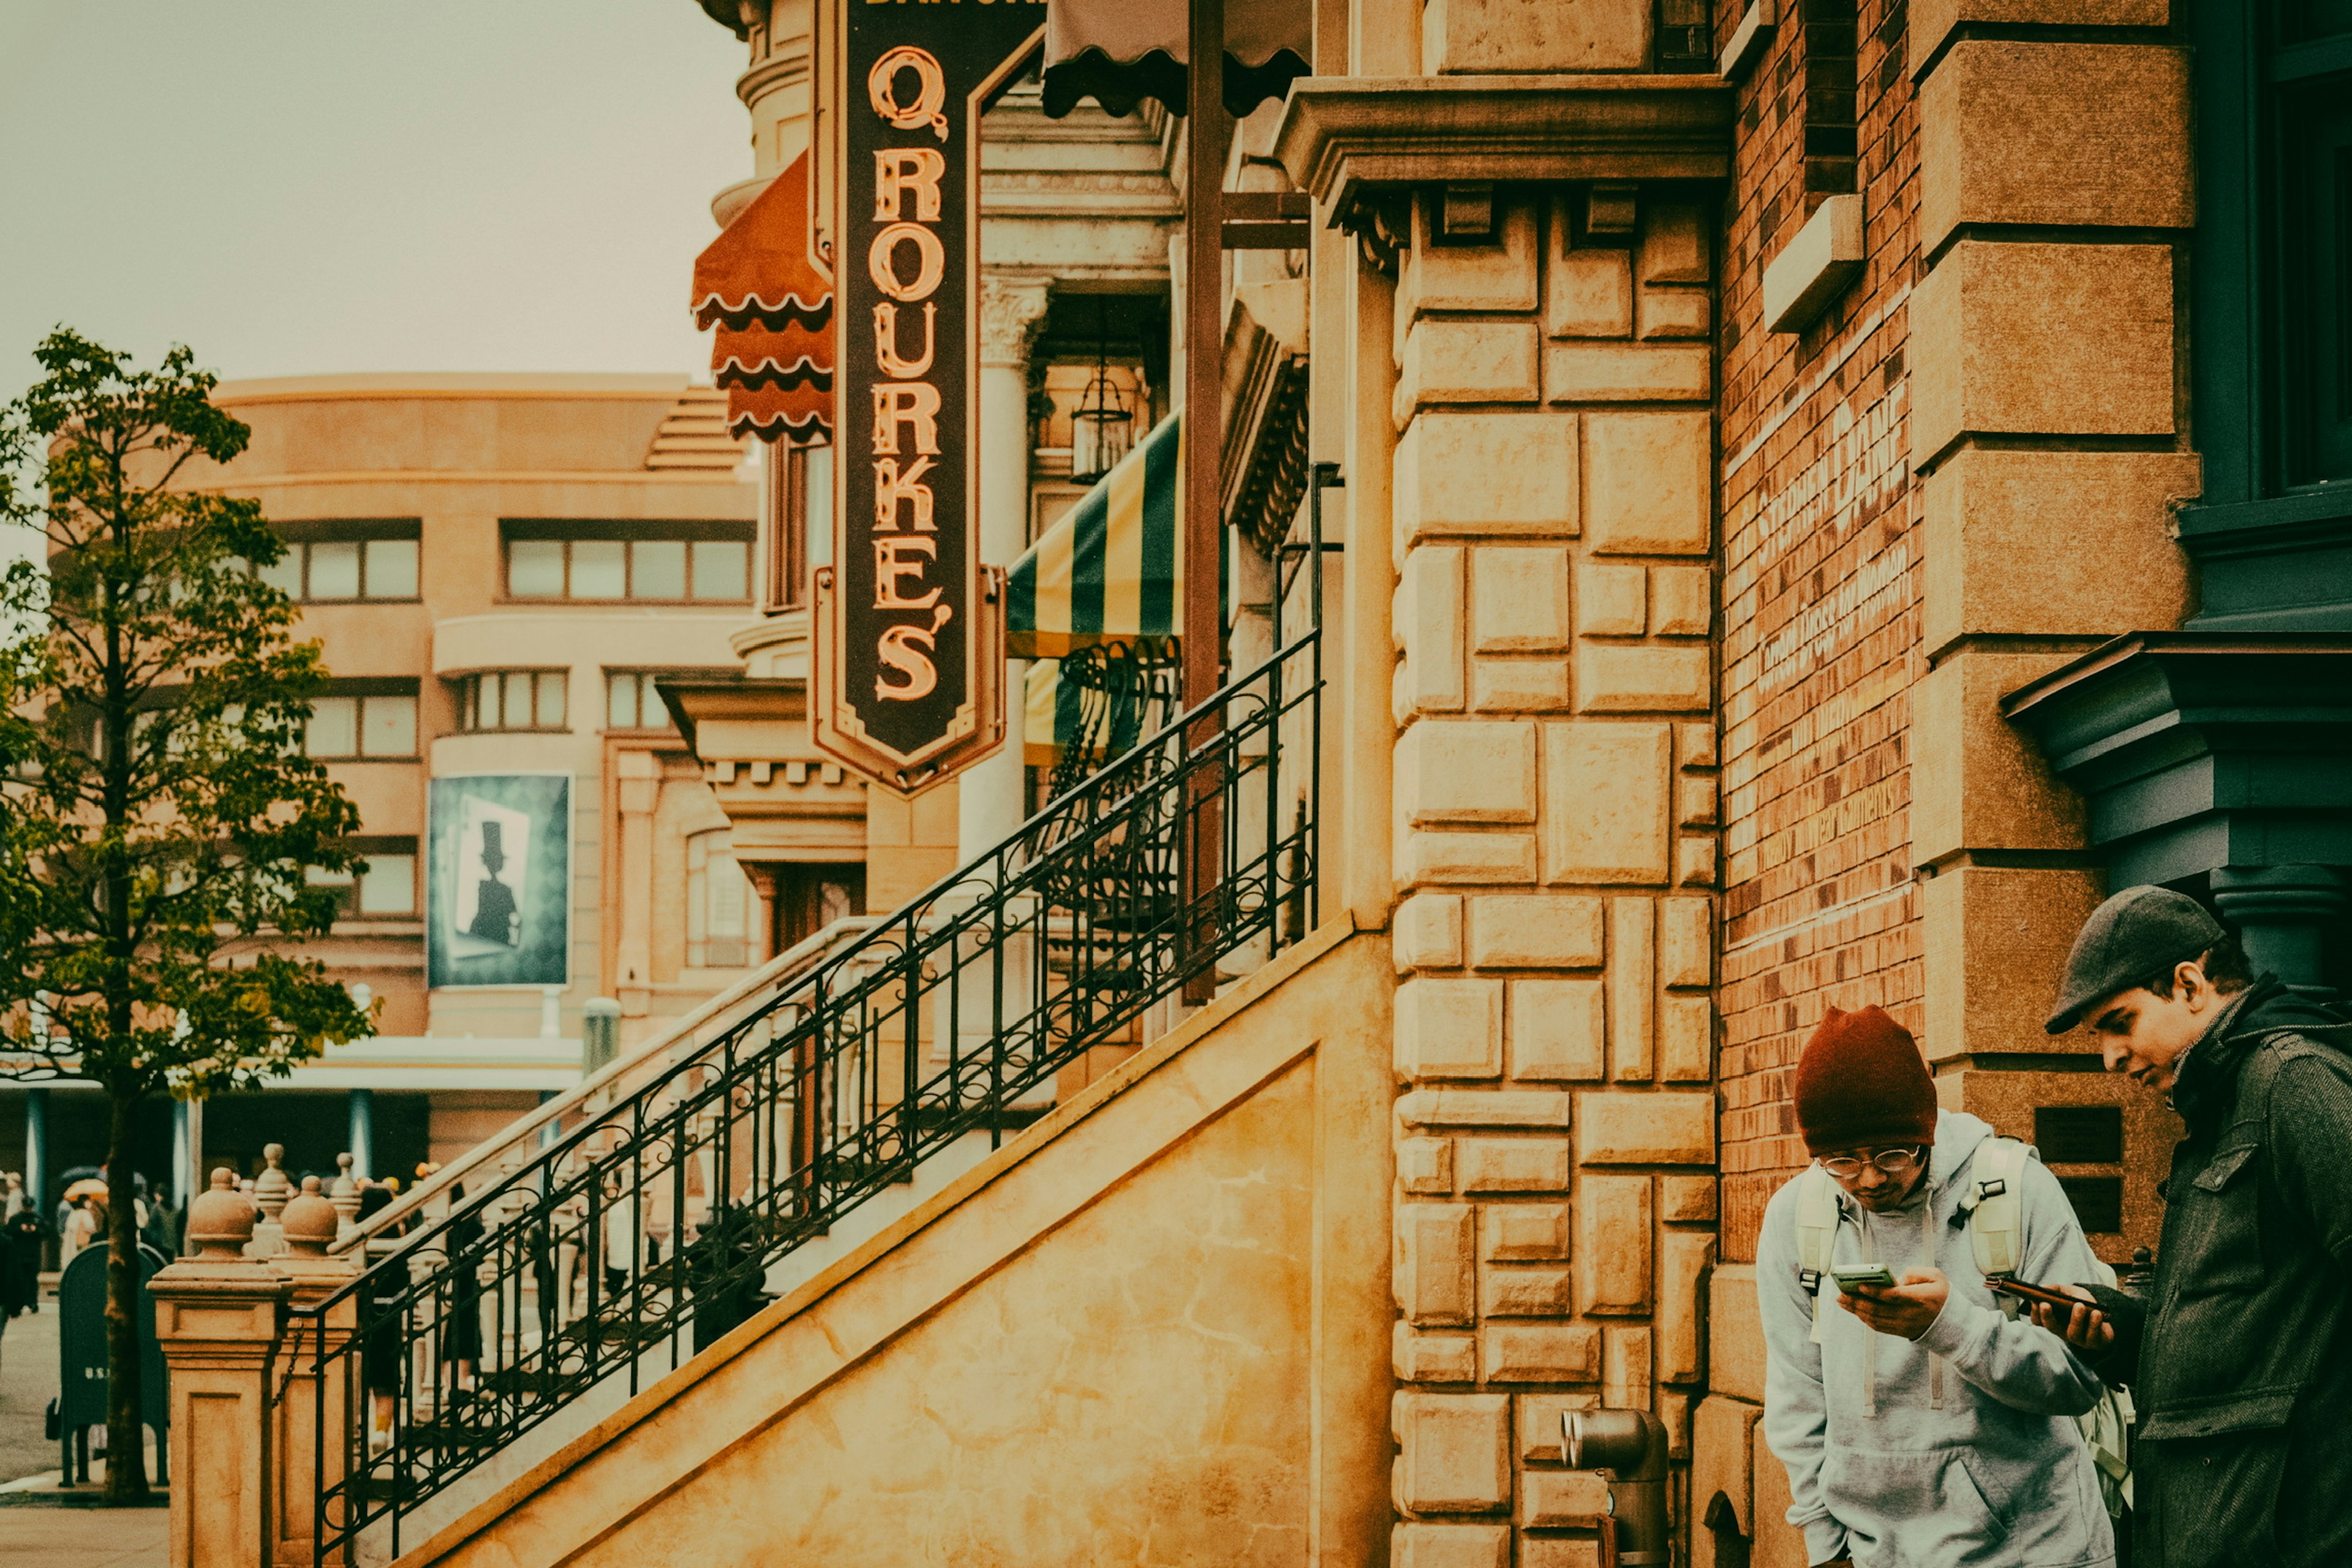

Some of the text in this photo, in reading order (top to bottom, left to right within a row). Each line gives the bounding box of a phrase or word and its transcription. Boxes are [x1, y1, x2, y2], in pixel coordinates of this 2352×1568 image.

[1758, 380, 1905, 566] STEPHEN DANE
[1800, 596, 1836, 669] Dress
[1857, 544, 1908, 626] Women
